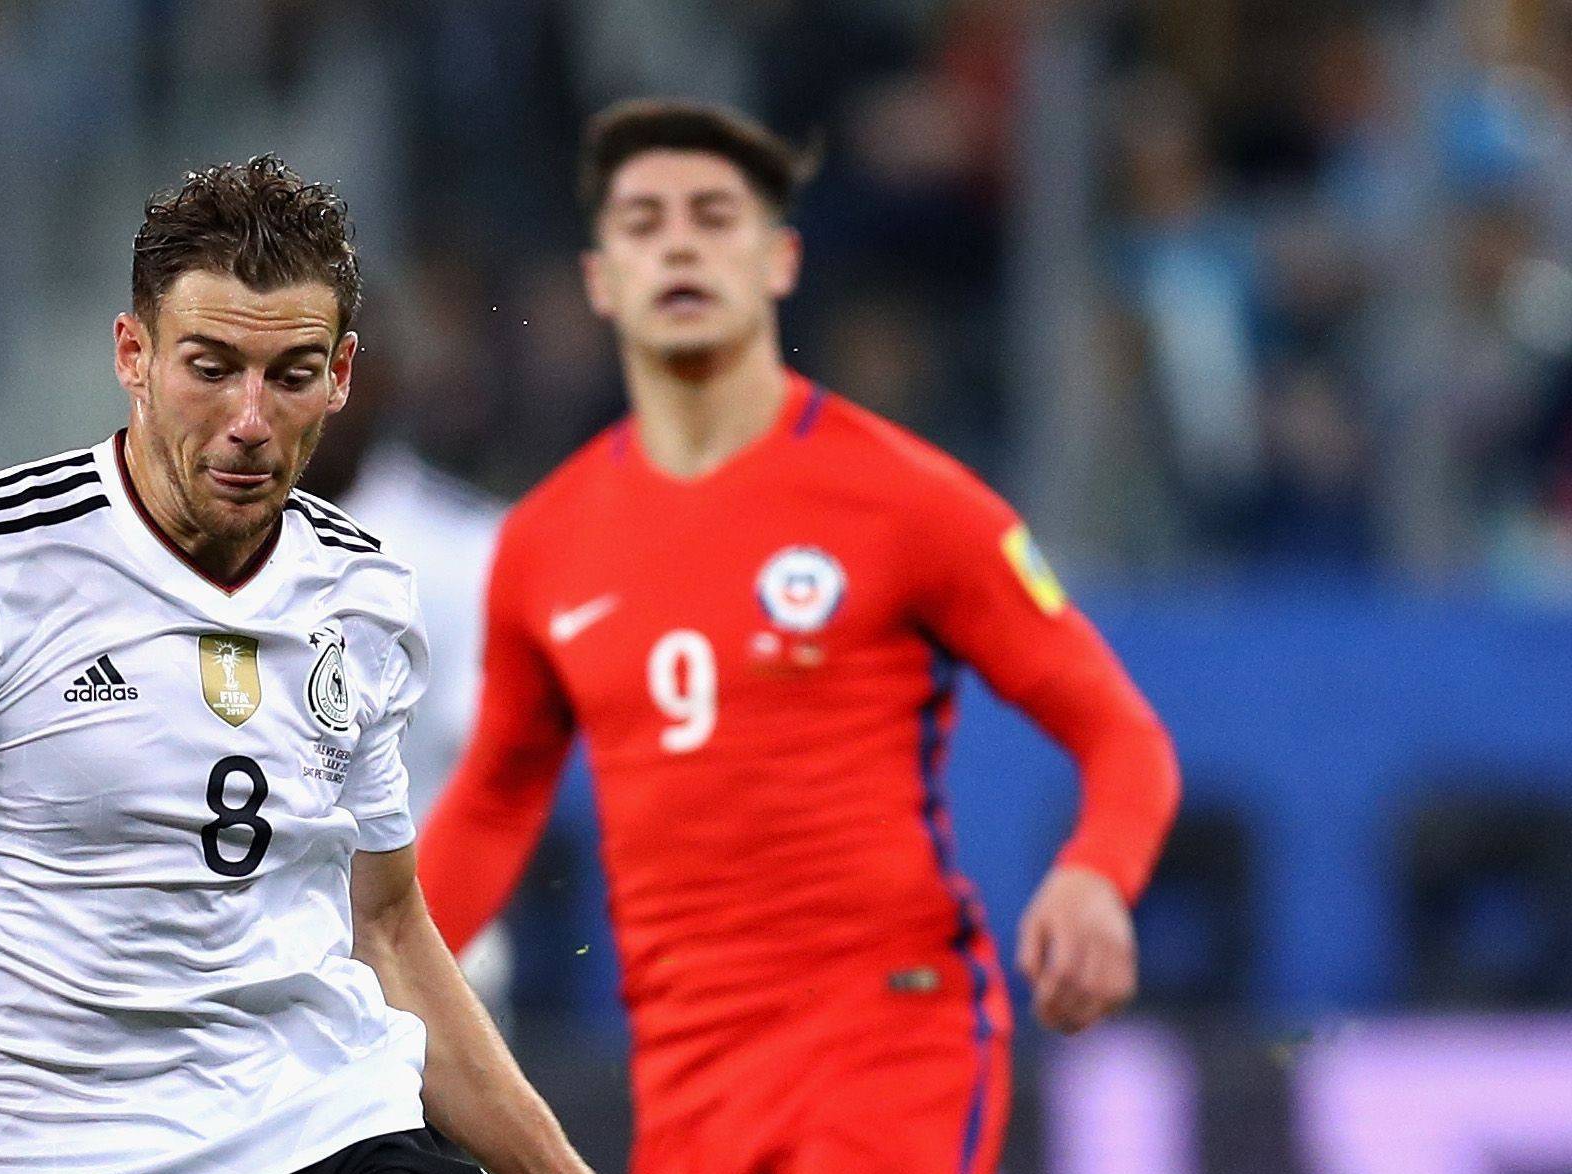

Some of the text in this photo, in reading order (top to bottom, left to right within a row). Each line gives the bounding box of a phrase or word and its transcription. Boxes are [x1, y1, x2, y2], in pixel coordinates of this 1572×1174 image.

[63, 684, 139, 703] adidas
[219, 690, 250, 704] FIFA
[646, 627, 719, 755] 9
[201, 754, 273, 878] 8
